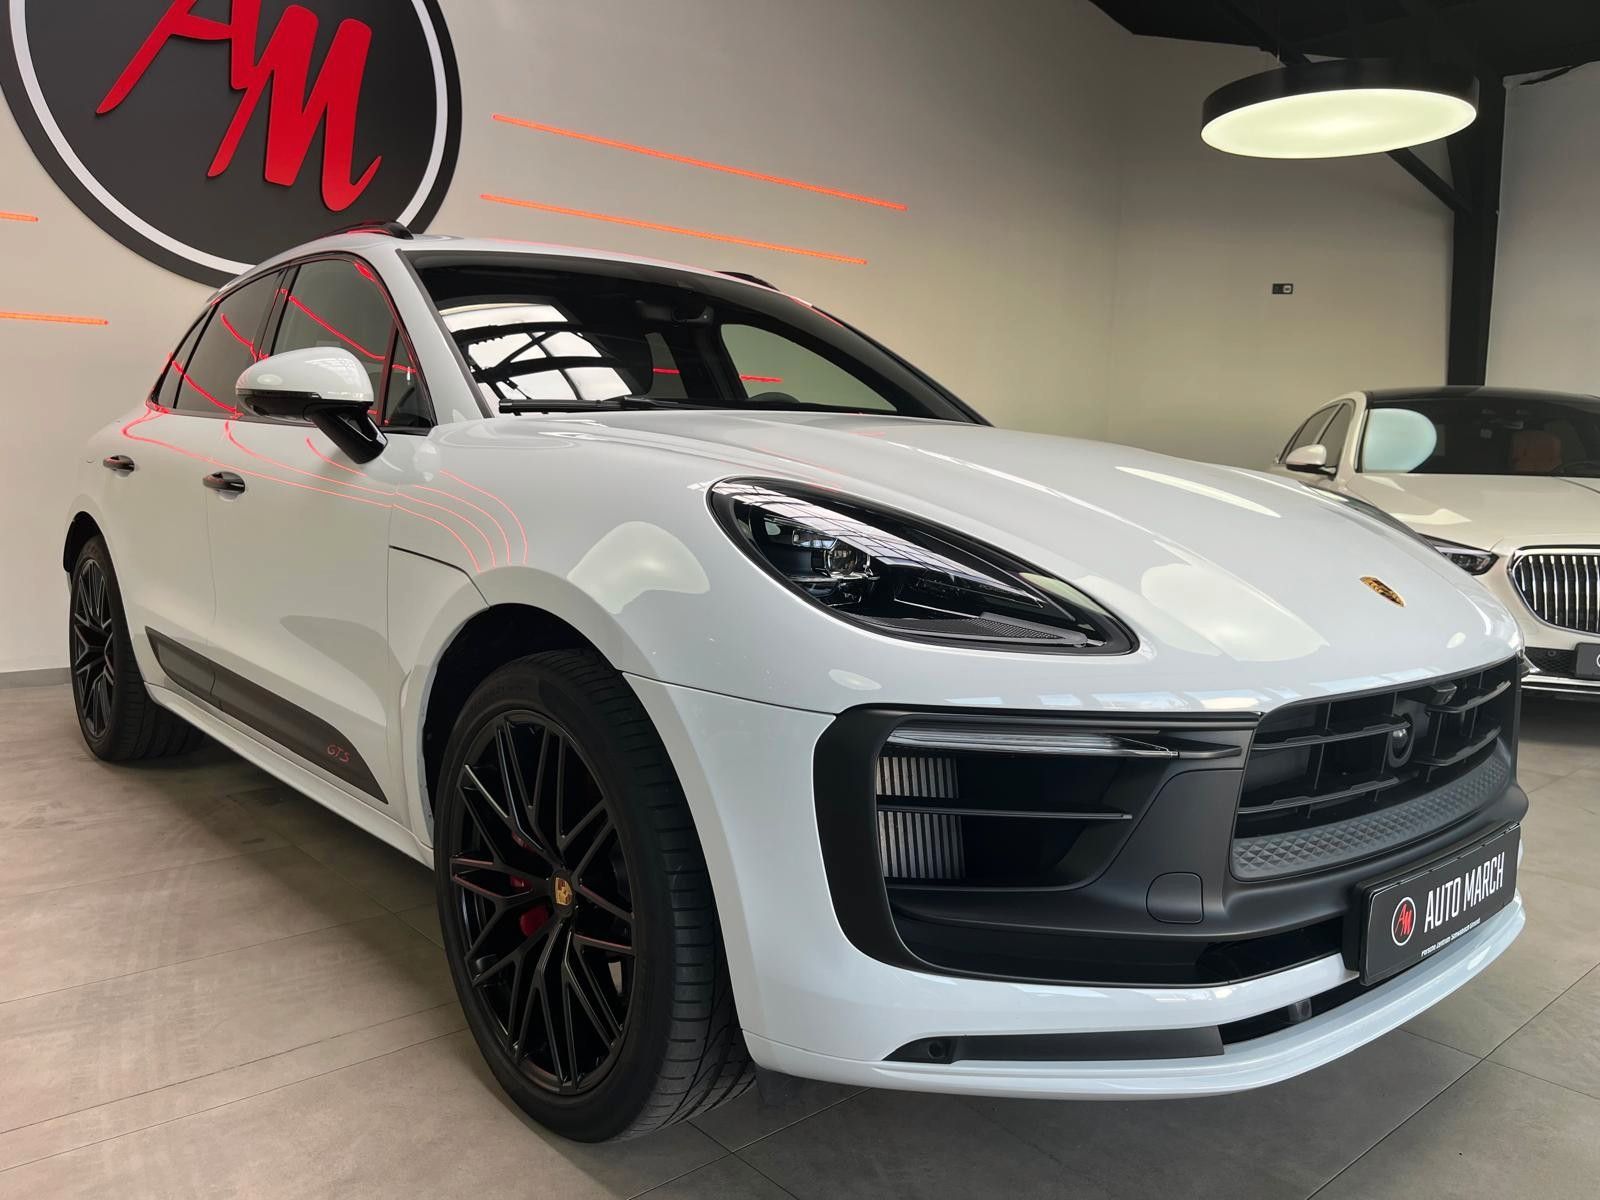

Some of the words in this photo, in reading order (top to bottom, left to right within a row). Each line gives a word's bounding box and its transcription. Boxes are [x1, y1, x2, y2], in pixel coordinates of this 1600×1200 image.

[95, 0, 382, 211] AM
[327, 744, 350, 763] GTS
[1424, 877, 1462, 933] AUTO
[1463, 852, 1505, 911] MARCH
